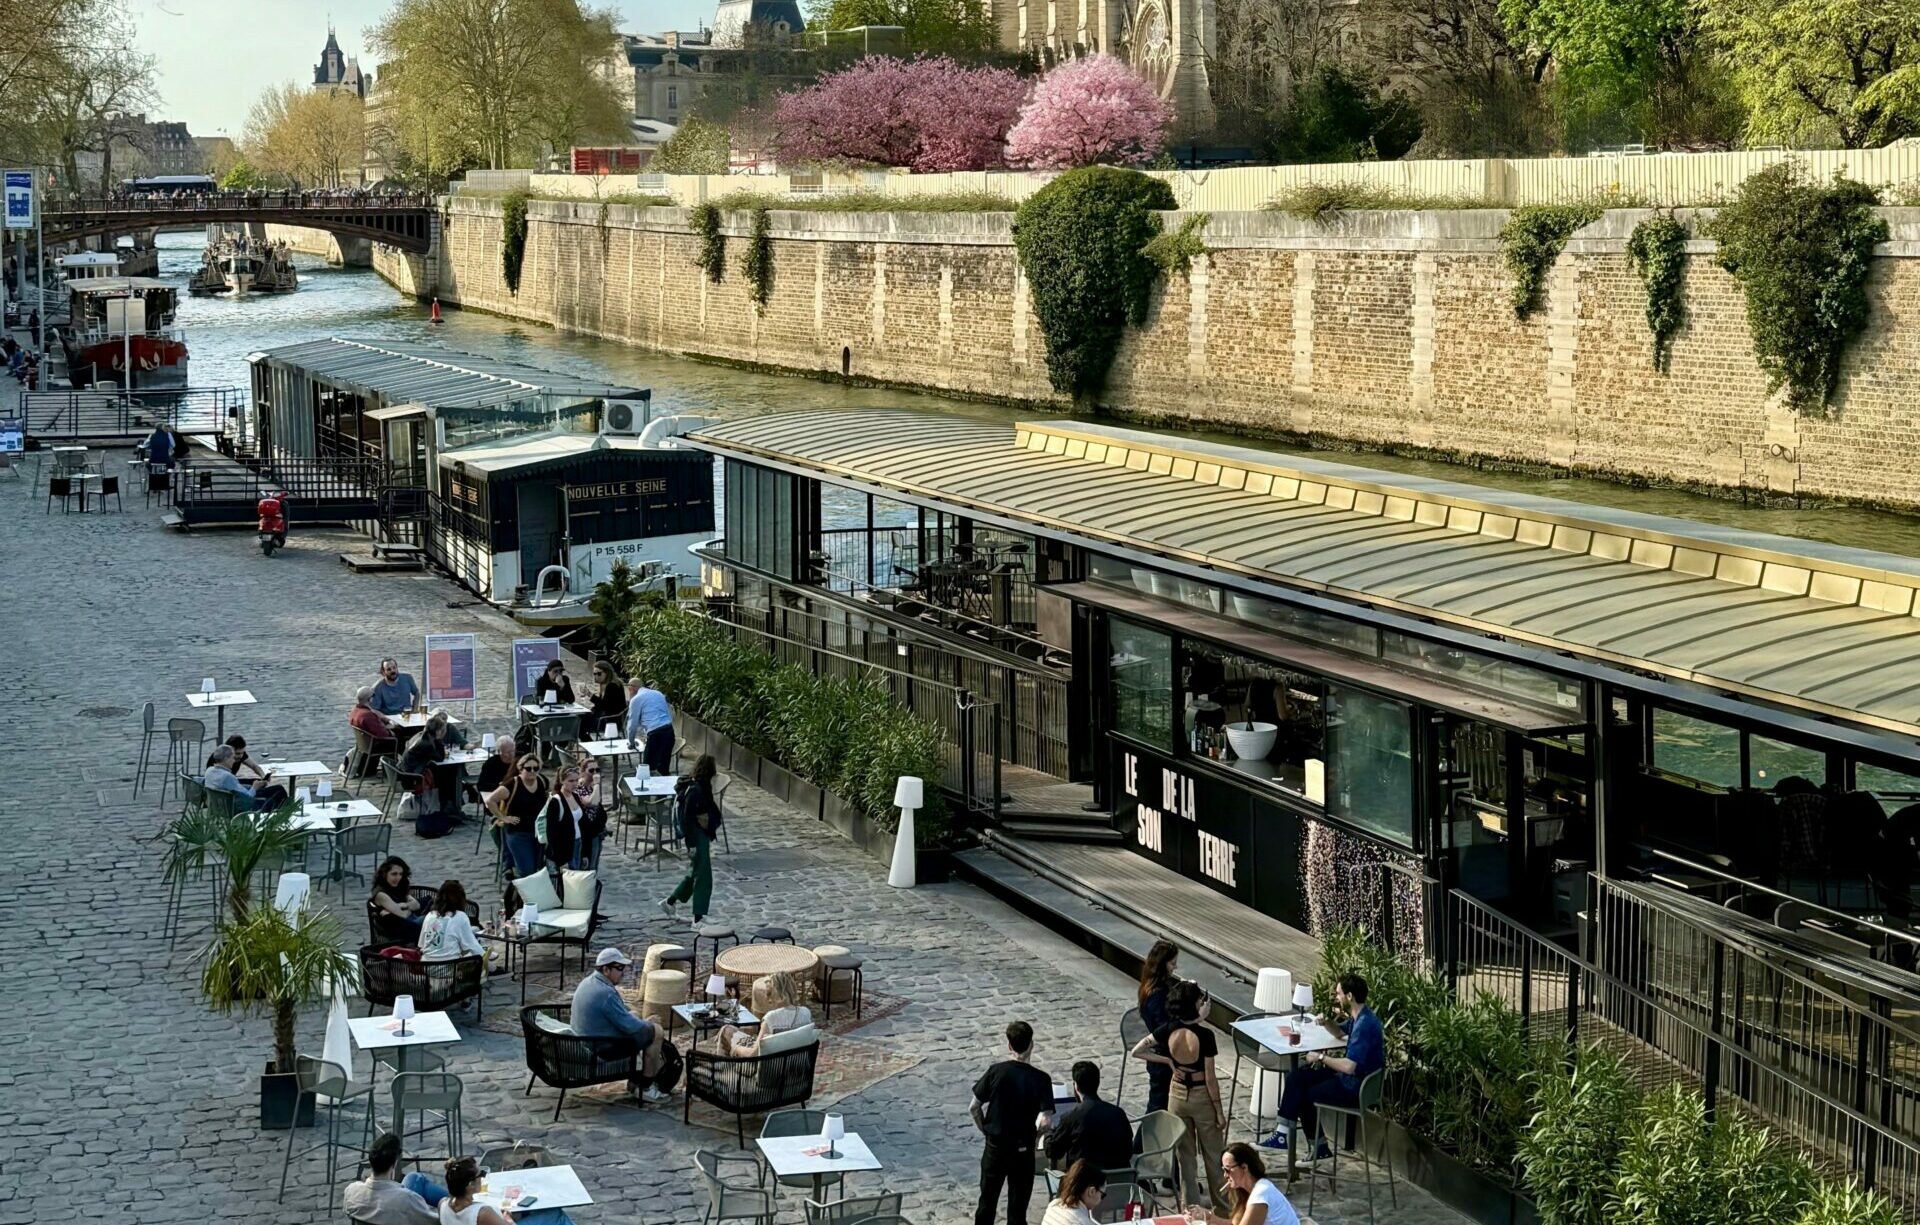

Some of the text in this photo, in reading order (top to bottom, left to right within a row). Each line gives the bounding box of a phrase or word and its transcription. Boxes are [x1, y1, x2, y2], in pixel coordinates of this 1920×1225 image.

[568, 479, 667, 500] NOUVELLE SEINE
[596, 543, 643, 557] P 15 558 F
[1125, 752, 1196, 822] LE DE LA
[1137, 803, 1237, 888] SON TERRE
